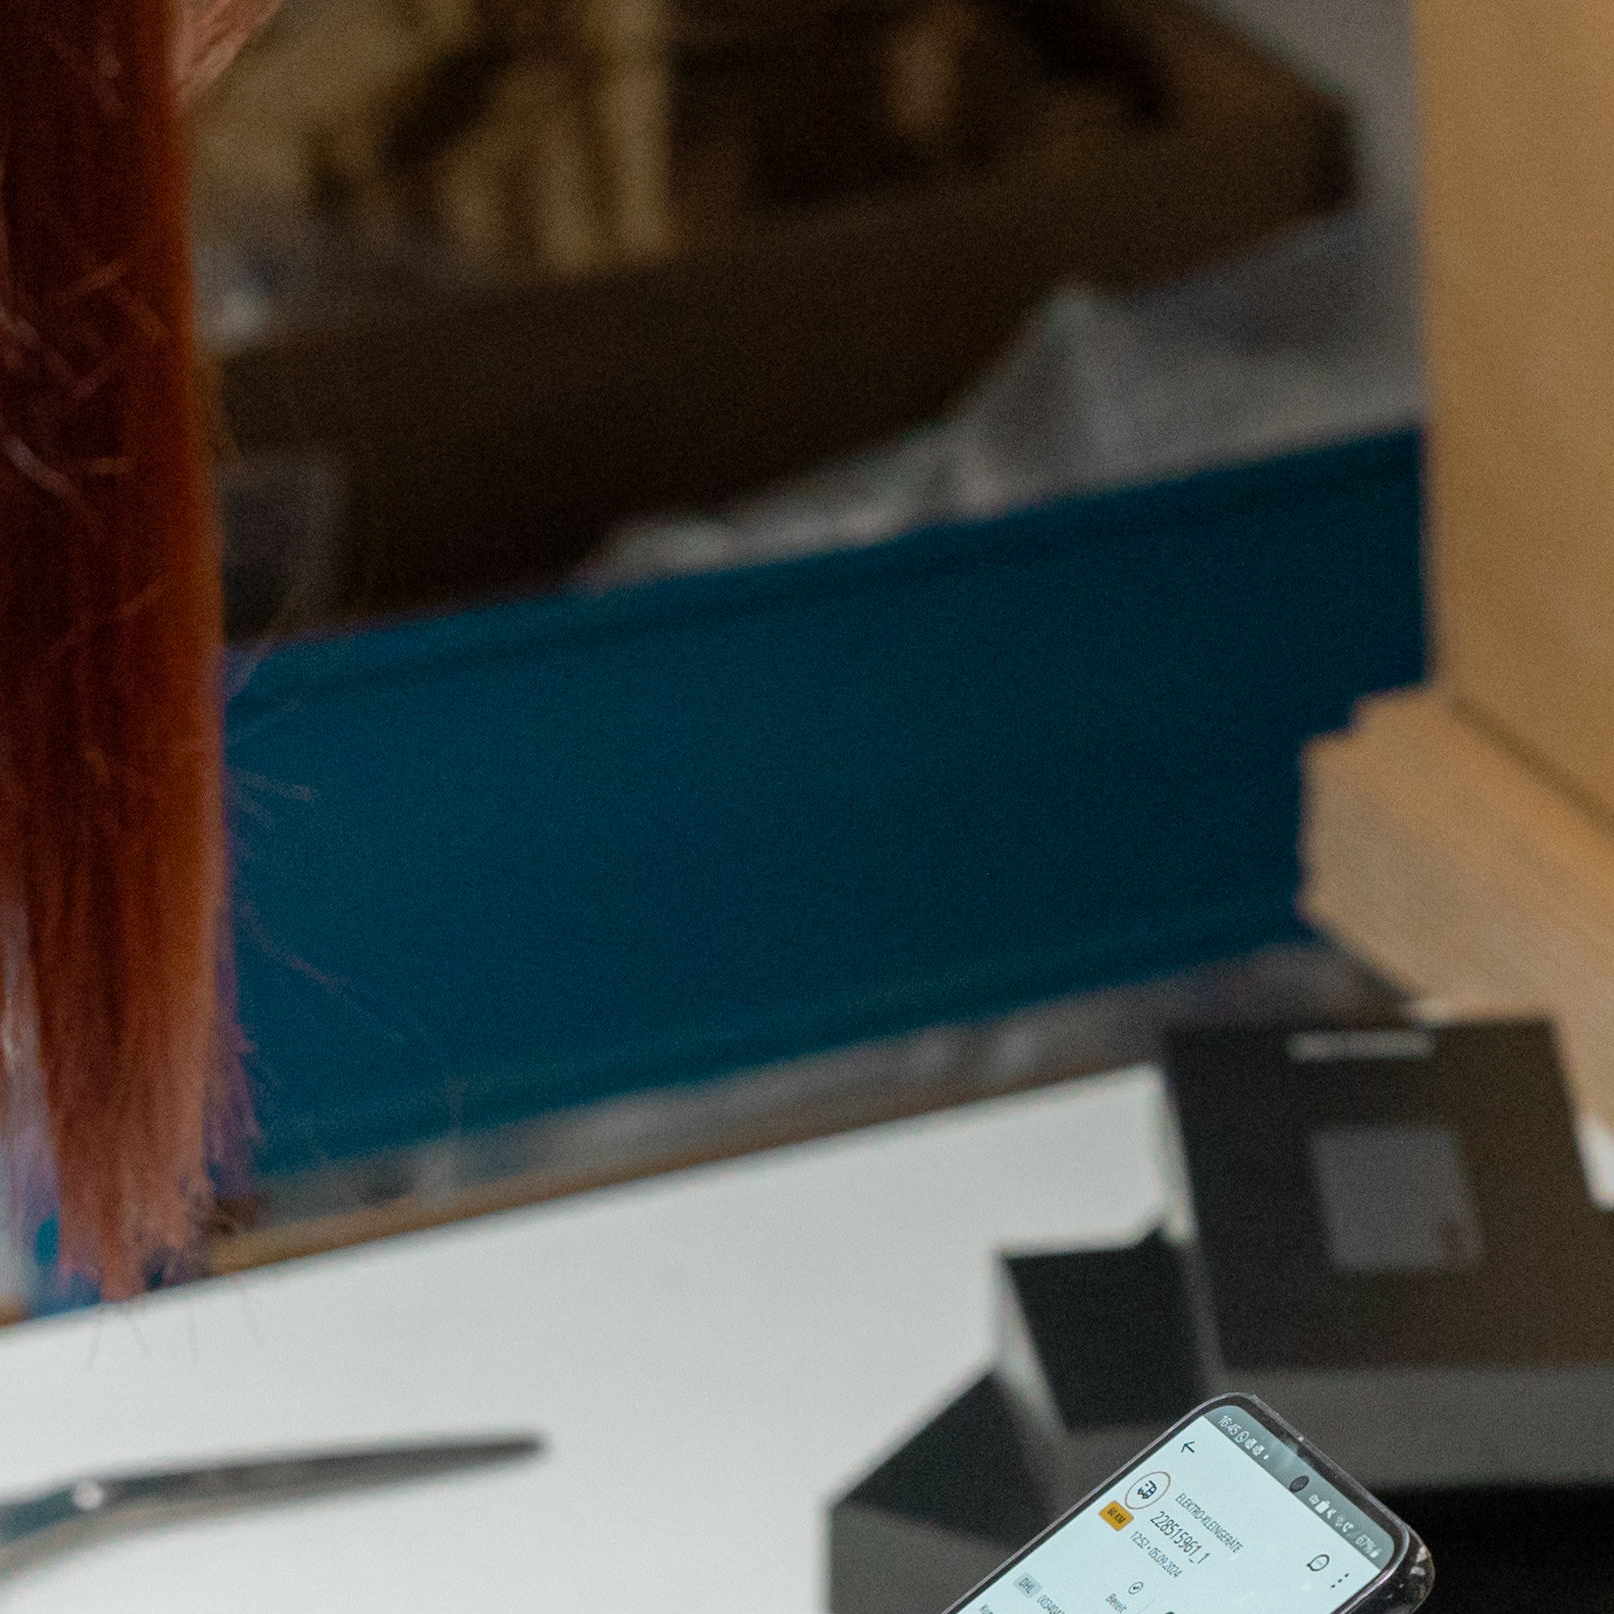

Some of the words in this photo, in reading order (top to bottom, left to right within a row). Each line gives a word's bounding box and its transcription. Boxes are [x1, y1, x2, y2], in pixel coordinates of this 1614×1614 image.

[1215, 1412, 1243, 1436] 16:45
[1174, 1492, 1243, 1553] ELEKTRO-KLEINGERÄTE
[1149, 1510, 1210, 1564] 228515961_1
[1147, 1546, 1182, 1578] 05.09.2024
[1018, 1577, 1035, 1594] DHL
[1105, 1592, 1127, 1613] Bereit
